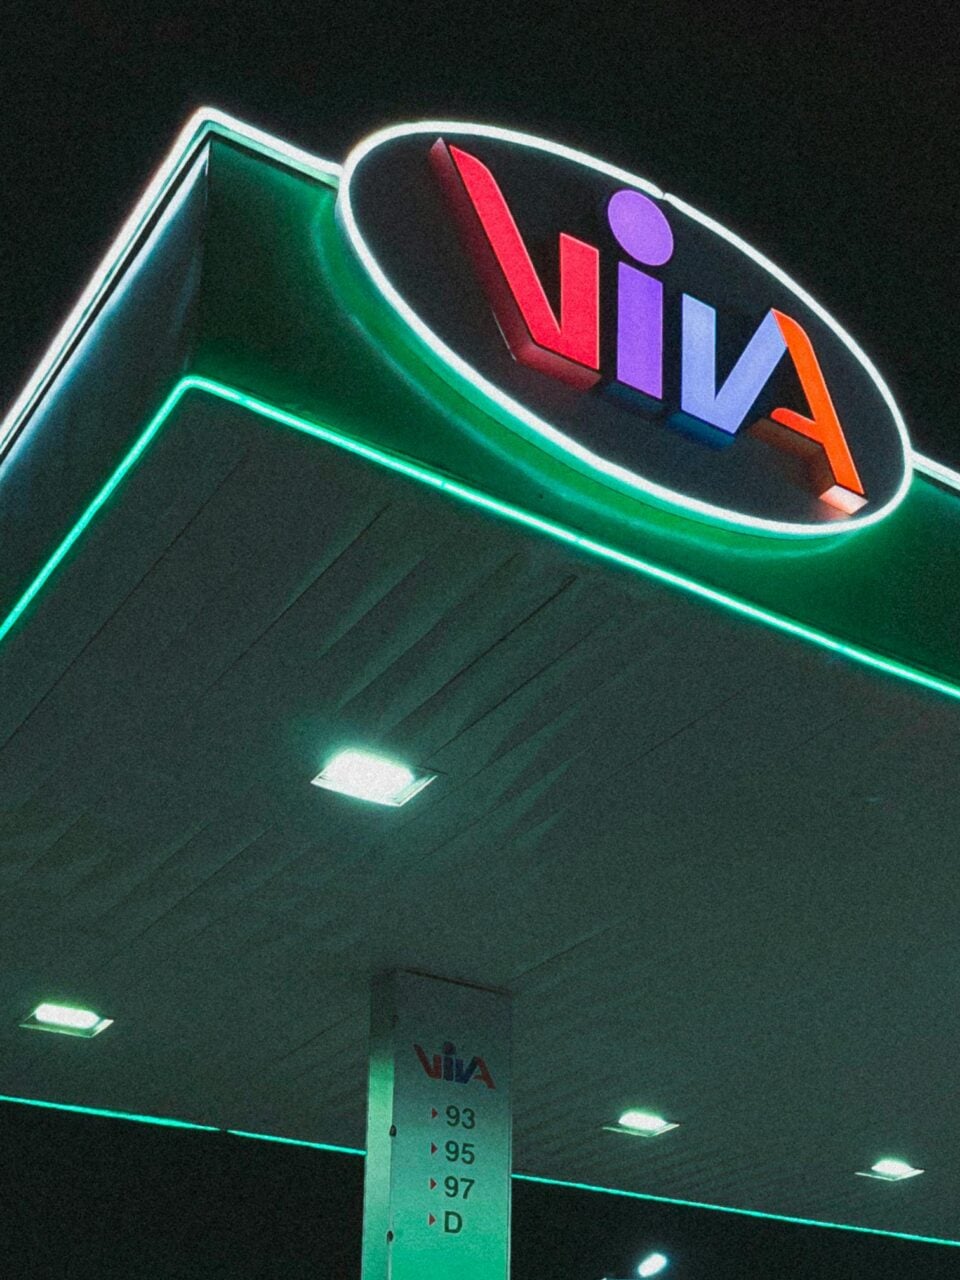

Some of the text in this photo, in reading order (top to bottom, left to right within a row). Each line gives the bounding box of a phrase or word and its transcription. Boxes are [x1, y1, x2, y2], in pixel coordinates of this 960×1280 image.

[445, 1105, 476, 1130] 93
[444, 1140, 476, 1165] 95
[443, 1175, 475, 1200] 97
[443, 1211, 463, 1234] D
